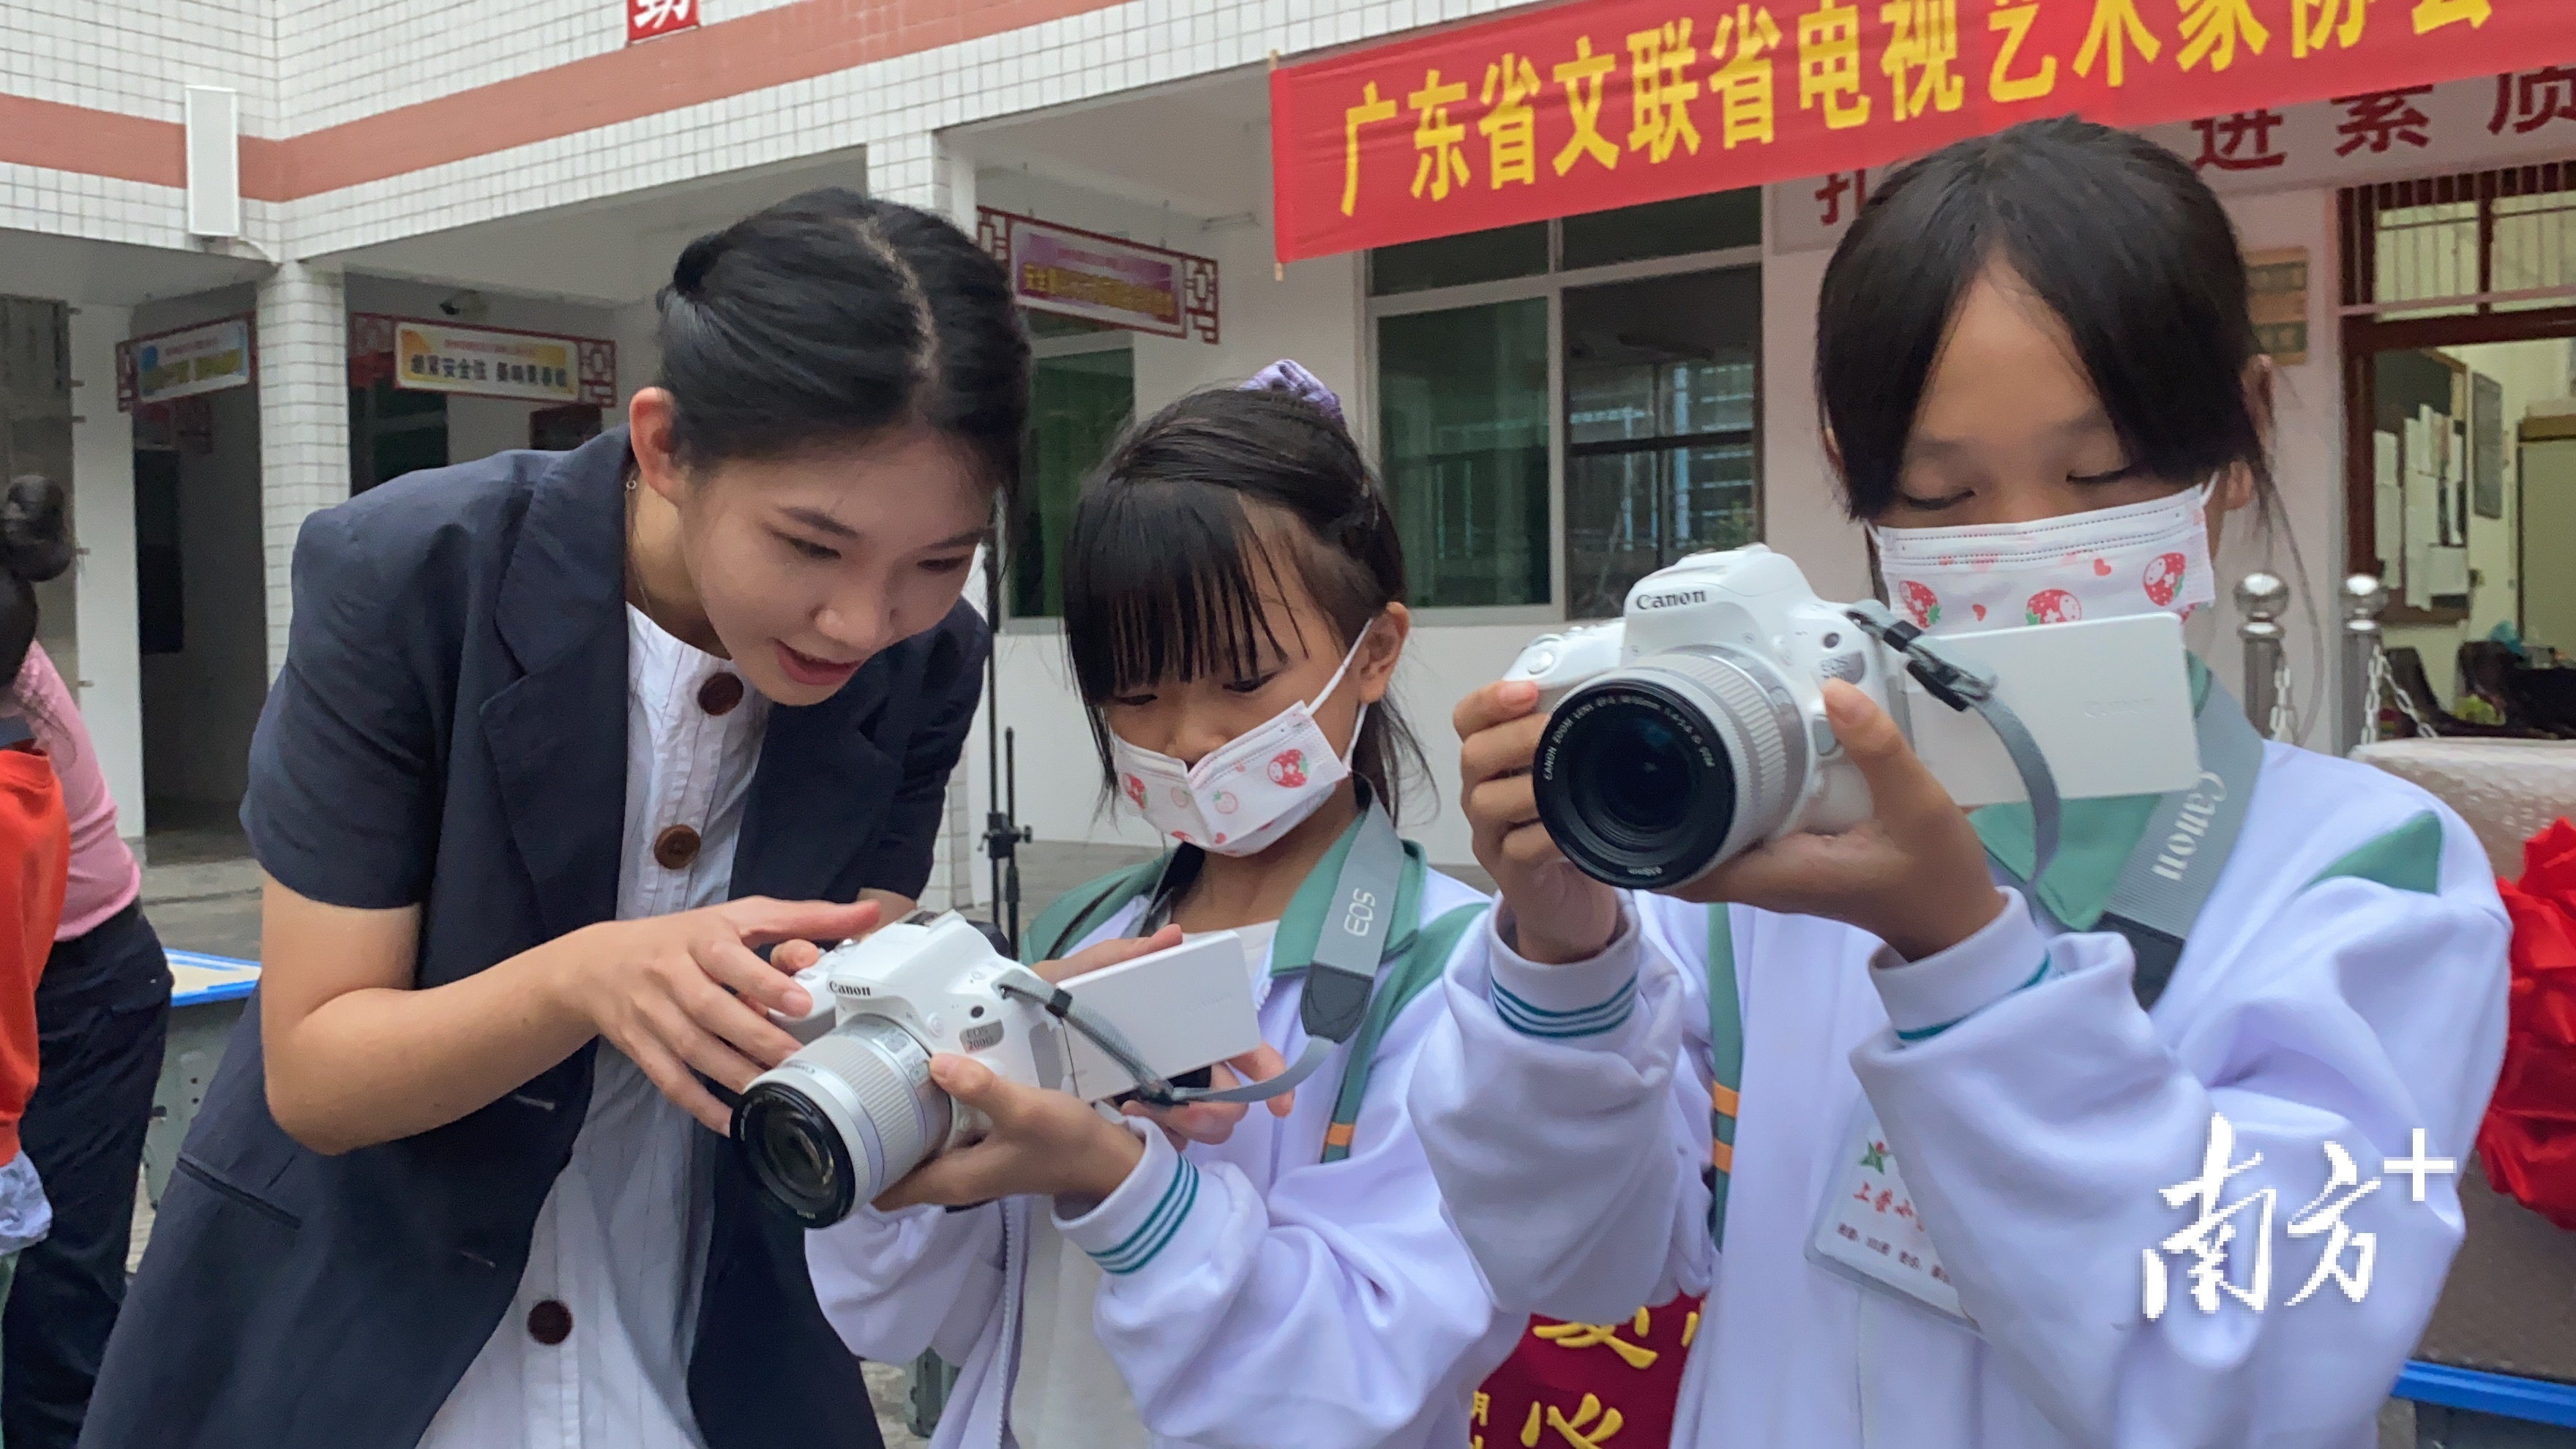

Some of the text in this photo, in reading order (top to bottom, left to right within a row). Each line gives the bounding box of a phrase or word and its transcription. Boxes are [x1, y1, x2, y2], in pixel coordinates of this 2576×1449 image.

[1636, 589, 1707, 610] Canon
[1543, 746, 1557, 781] CANON
[1551, 717, 1574, 744] ZOOM
[2151, 771, 2228, 882] Canon
[1344, 887, 1376, 937] EOS
[829, 981, 872, 997] Canon
